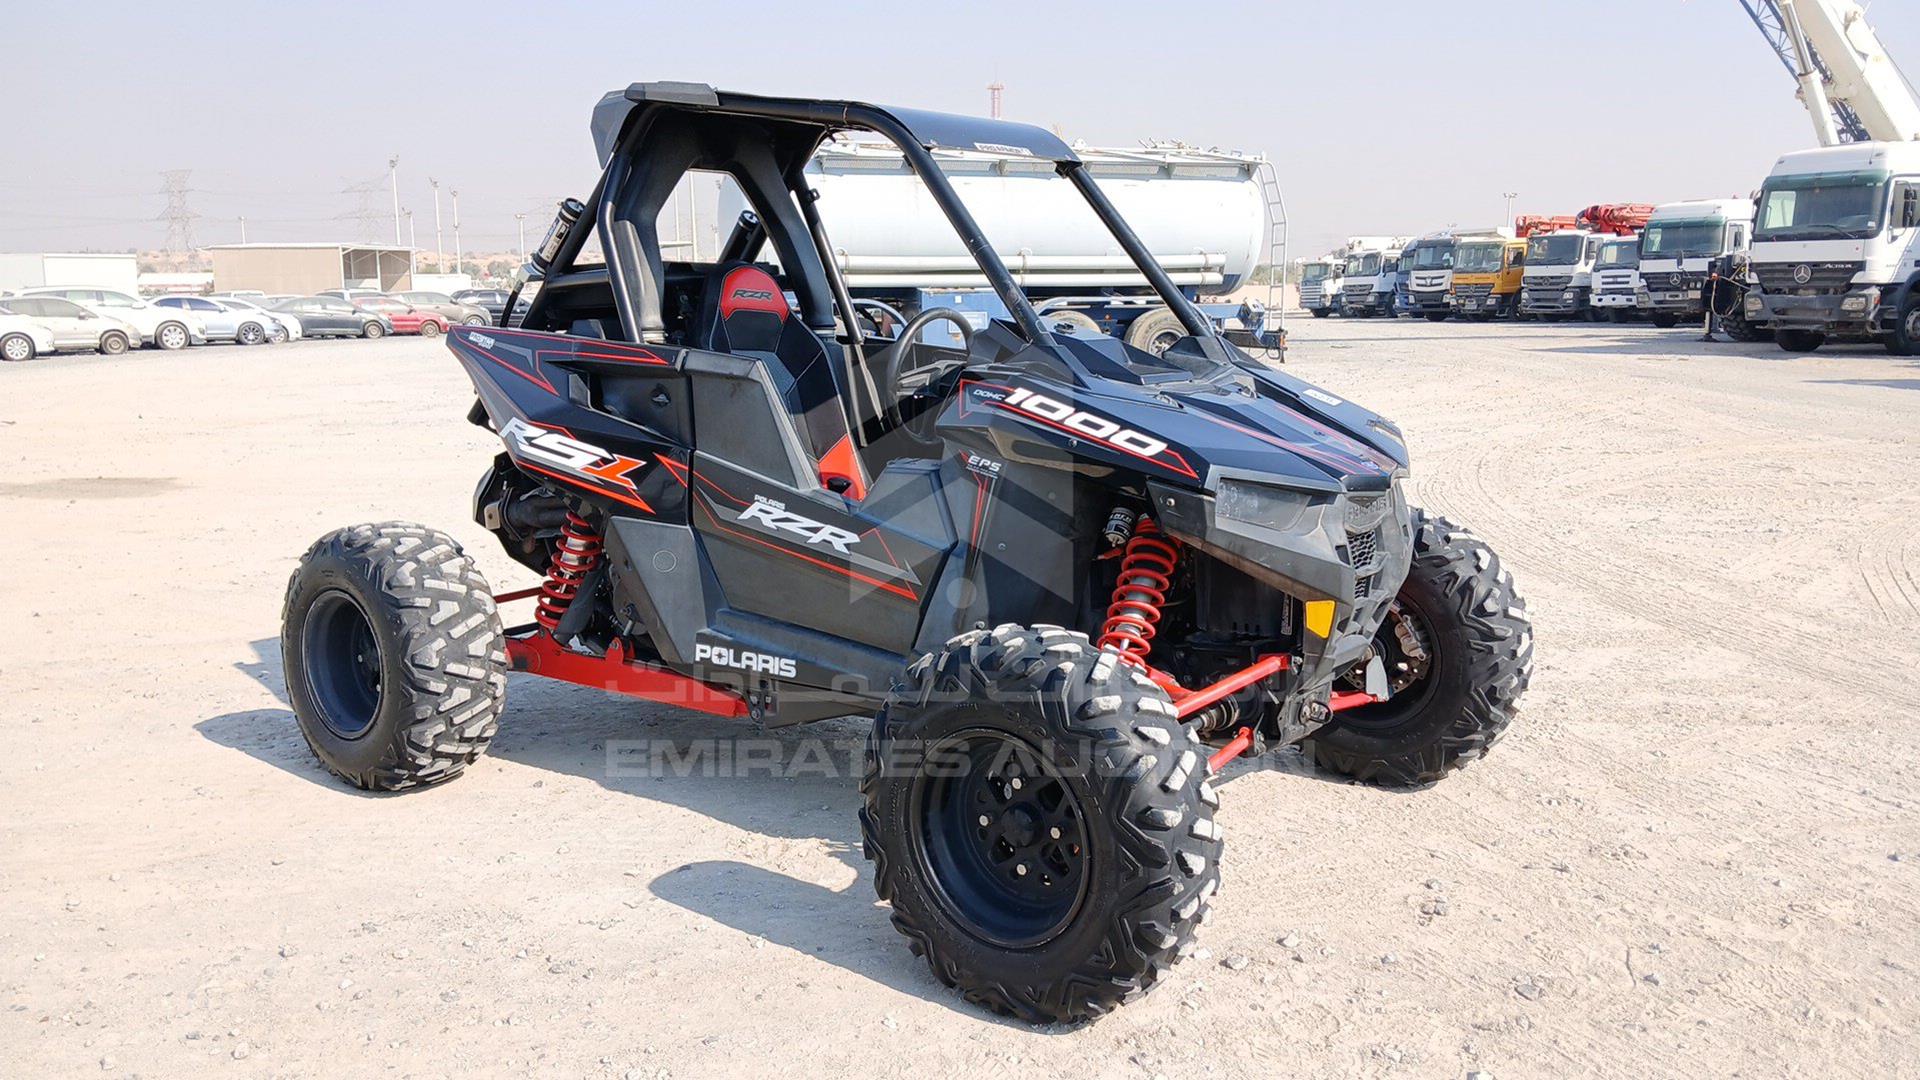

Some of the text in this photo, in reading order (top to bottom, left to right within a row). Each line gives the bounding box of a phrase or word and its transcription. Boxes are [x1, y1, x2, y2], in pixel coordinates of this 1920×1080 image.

[732, 289, 772, 301] RZR
[1004, 386, 1168, 457] 1000
[499, 416, 648, 490] RS1
[968, 455, 1002, 472] EPS
[754, 494, 786, 510] POLARIS
[737, 501, 862, 555] RZR
[695, 643, 798, 679] POLARIS
